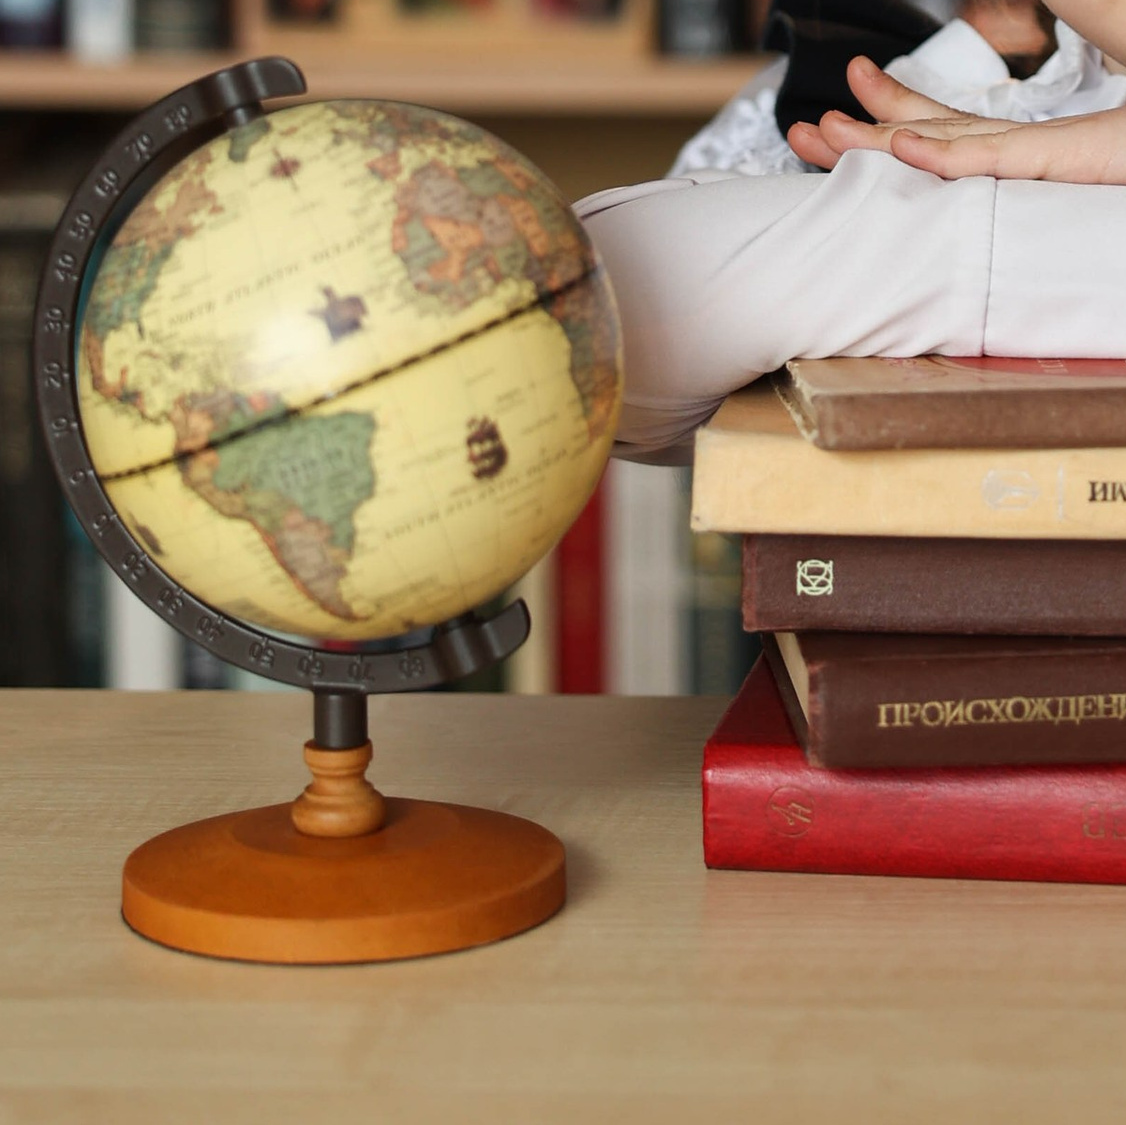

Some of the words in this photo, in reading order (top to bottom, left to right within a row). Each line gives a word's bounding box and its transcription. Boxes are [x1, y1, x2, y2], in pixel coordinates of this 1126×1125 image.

[95, 170, 118, 197] 60
[69, 212, 92, 239] 50
[56, 253, 76, 281] 40
[43, 362, 61, 388] 20
